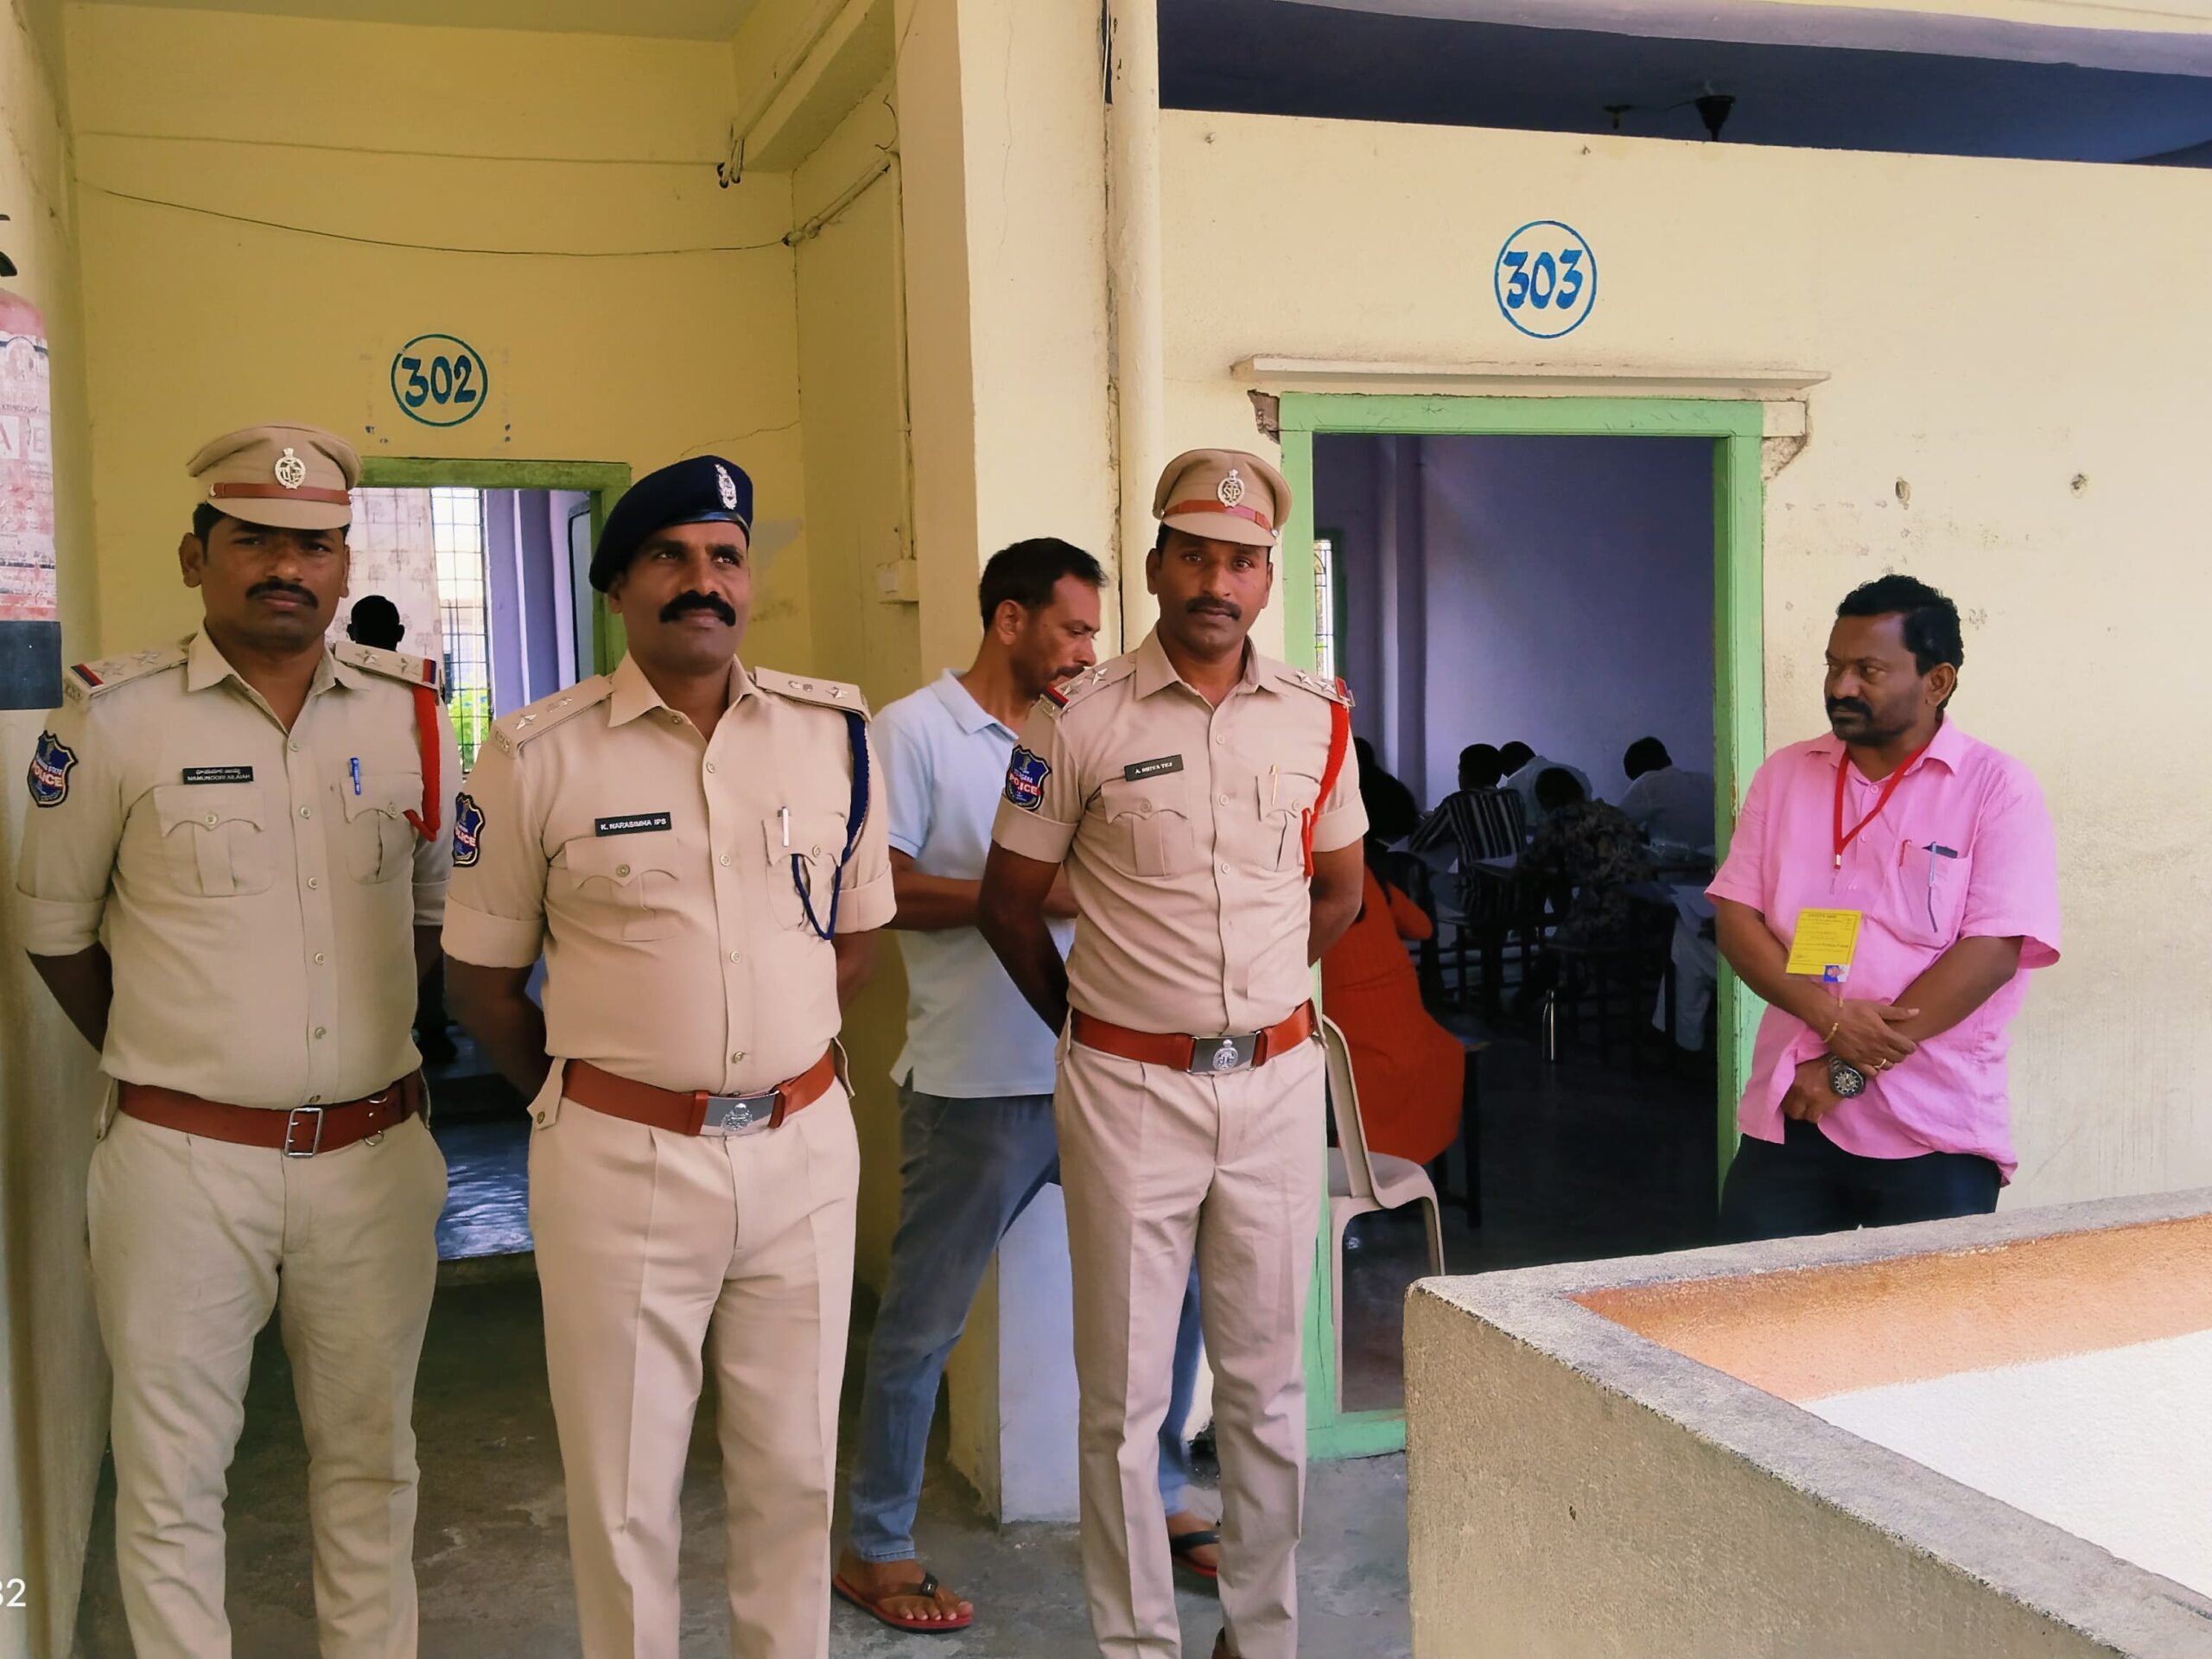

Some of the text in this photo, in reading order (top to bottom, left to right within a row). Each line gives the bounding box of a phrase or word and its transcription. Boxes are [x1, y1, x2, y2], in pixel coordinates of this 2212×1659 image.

[1503, 248, 1583, 309] 303
[402, 354, 476, 408] 302
[455, 826, 476, 847] LICE
